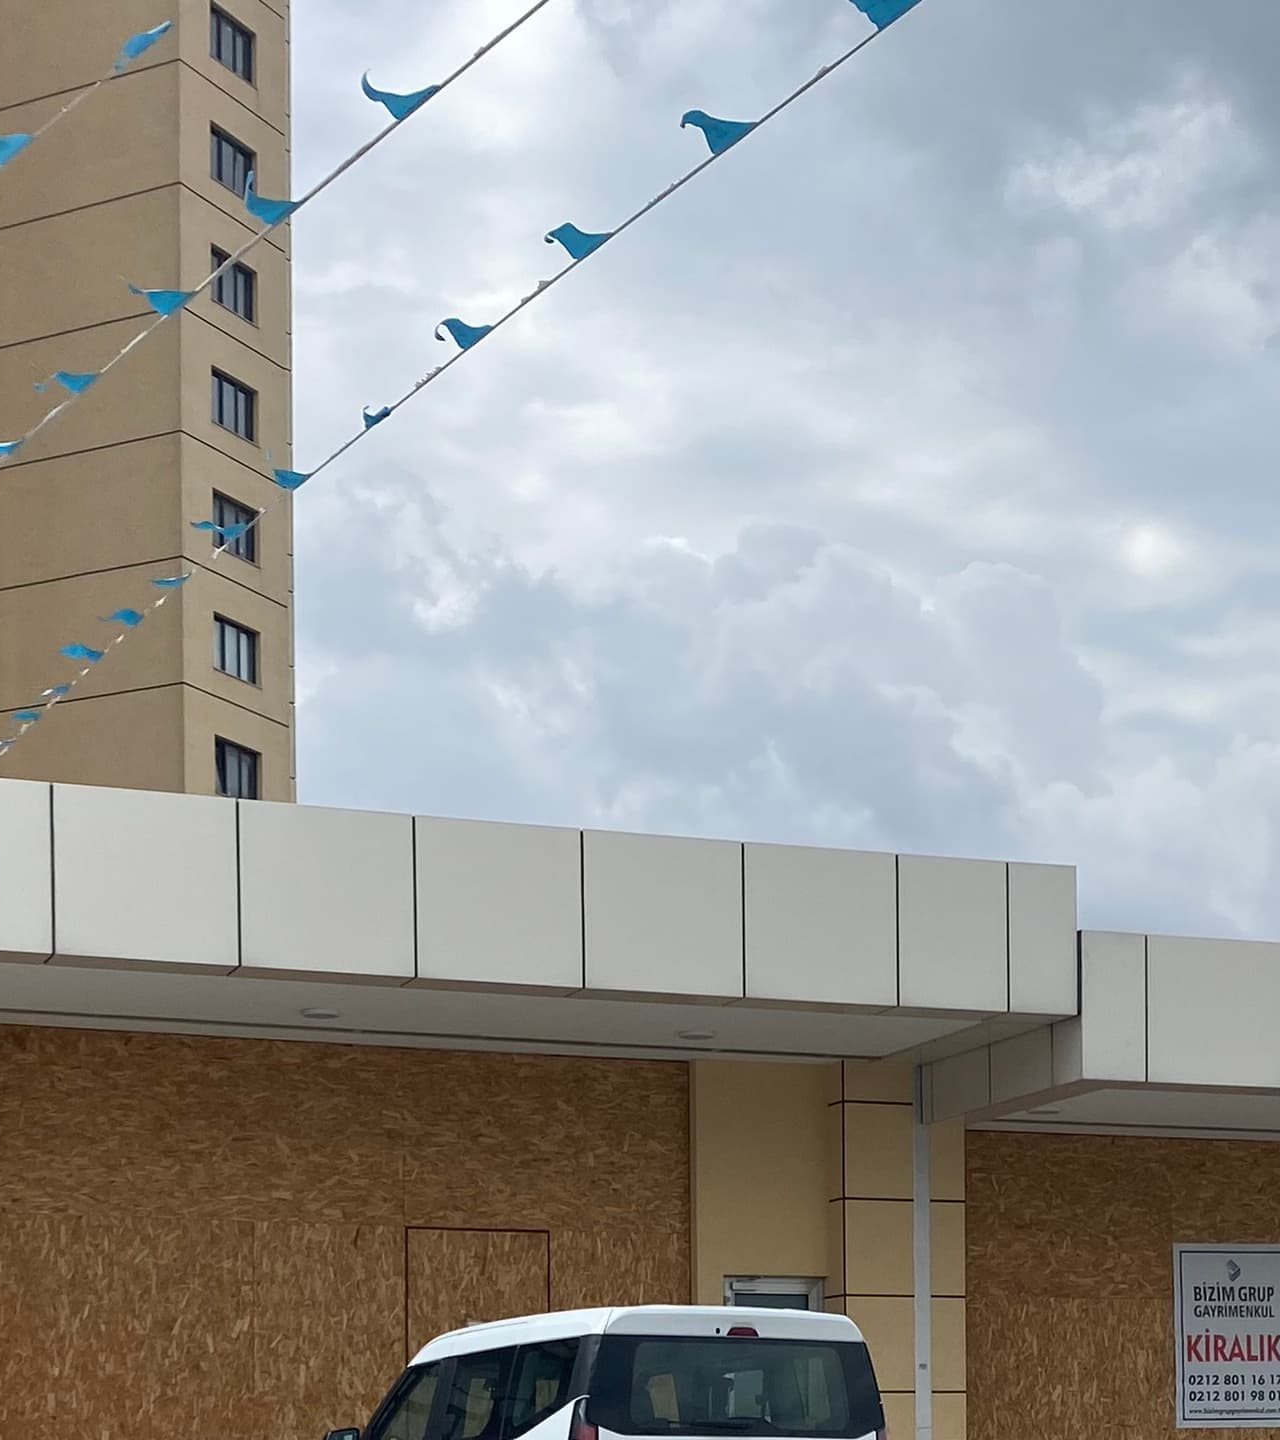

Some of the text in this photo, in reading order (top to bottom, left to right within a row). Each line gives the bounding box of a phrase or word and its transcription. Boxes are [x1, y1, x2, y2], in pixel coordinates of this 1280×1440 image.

[1193, 1281, 1275, 1302] BİZİM GRUP
[1193, 1303, 1275, 1318] GAYRİMENKUL
[1188, 1374, 1220, 1386] 0212
[1223, 1374, 1246, 1386] 801
[1251, 1374, 1266, 1386] 16
[1188, 1390, 1220, 1402] 0212
[1224, 1390, 1245, 1402] 801
[1250, 1390, 1265, 1402] 98
